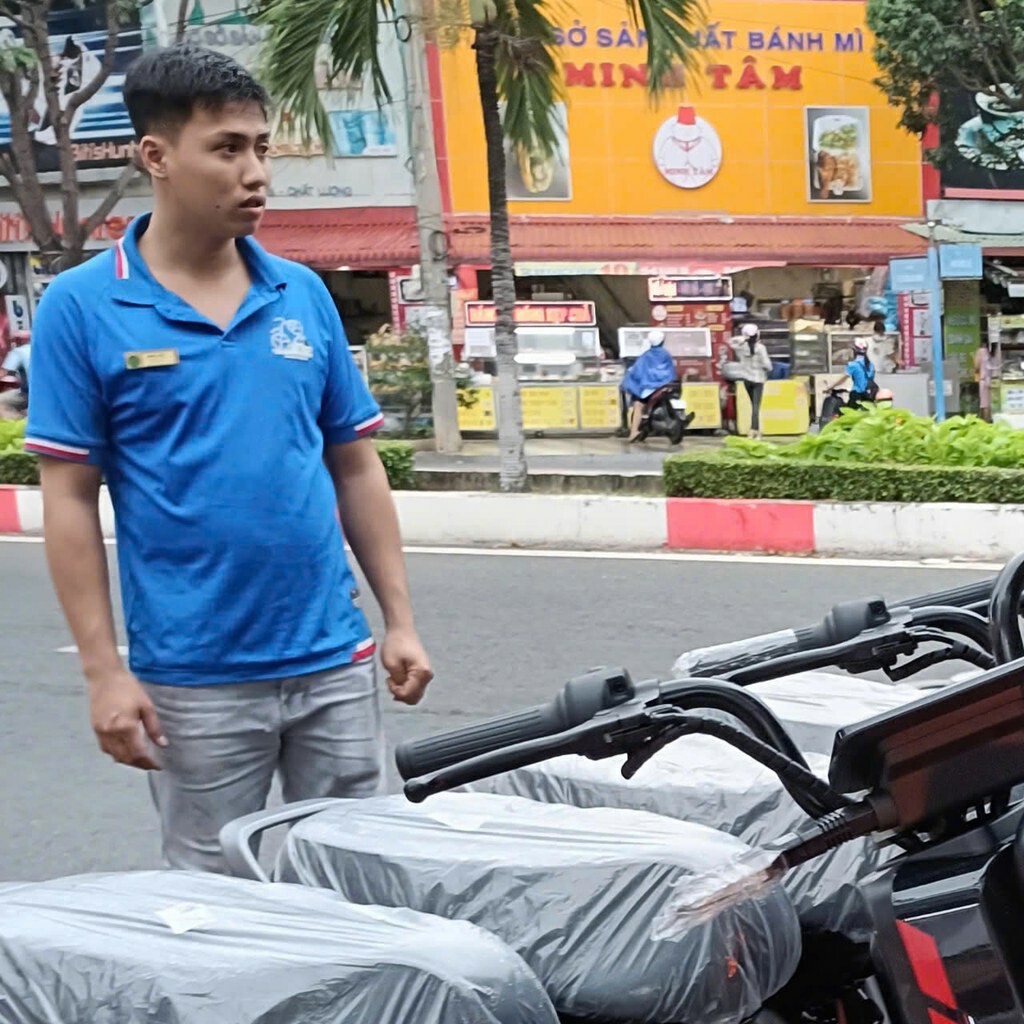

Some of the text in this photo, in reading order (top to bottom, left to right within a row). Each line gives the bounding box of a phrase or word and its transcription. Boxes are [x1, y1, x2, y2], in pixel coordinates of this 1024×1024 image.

[748, 25, 823, 50] BÁNH
[834, 27, 863, 52] MÌ
[705, 55, 803, 91] TÂM
